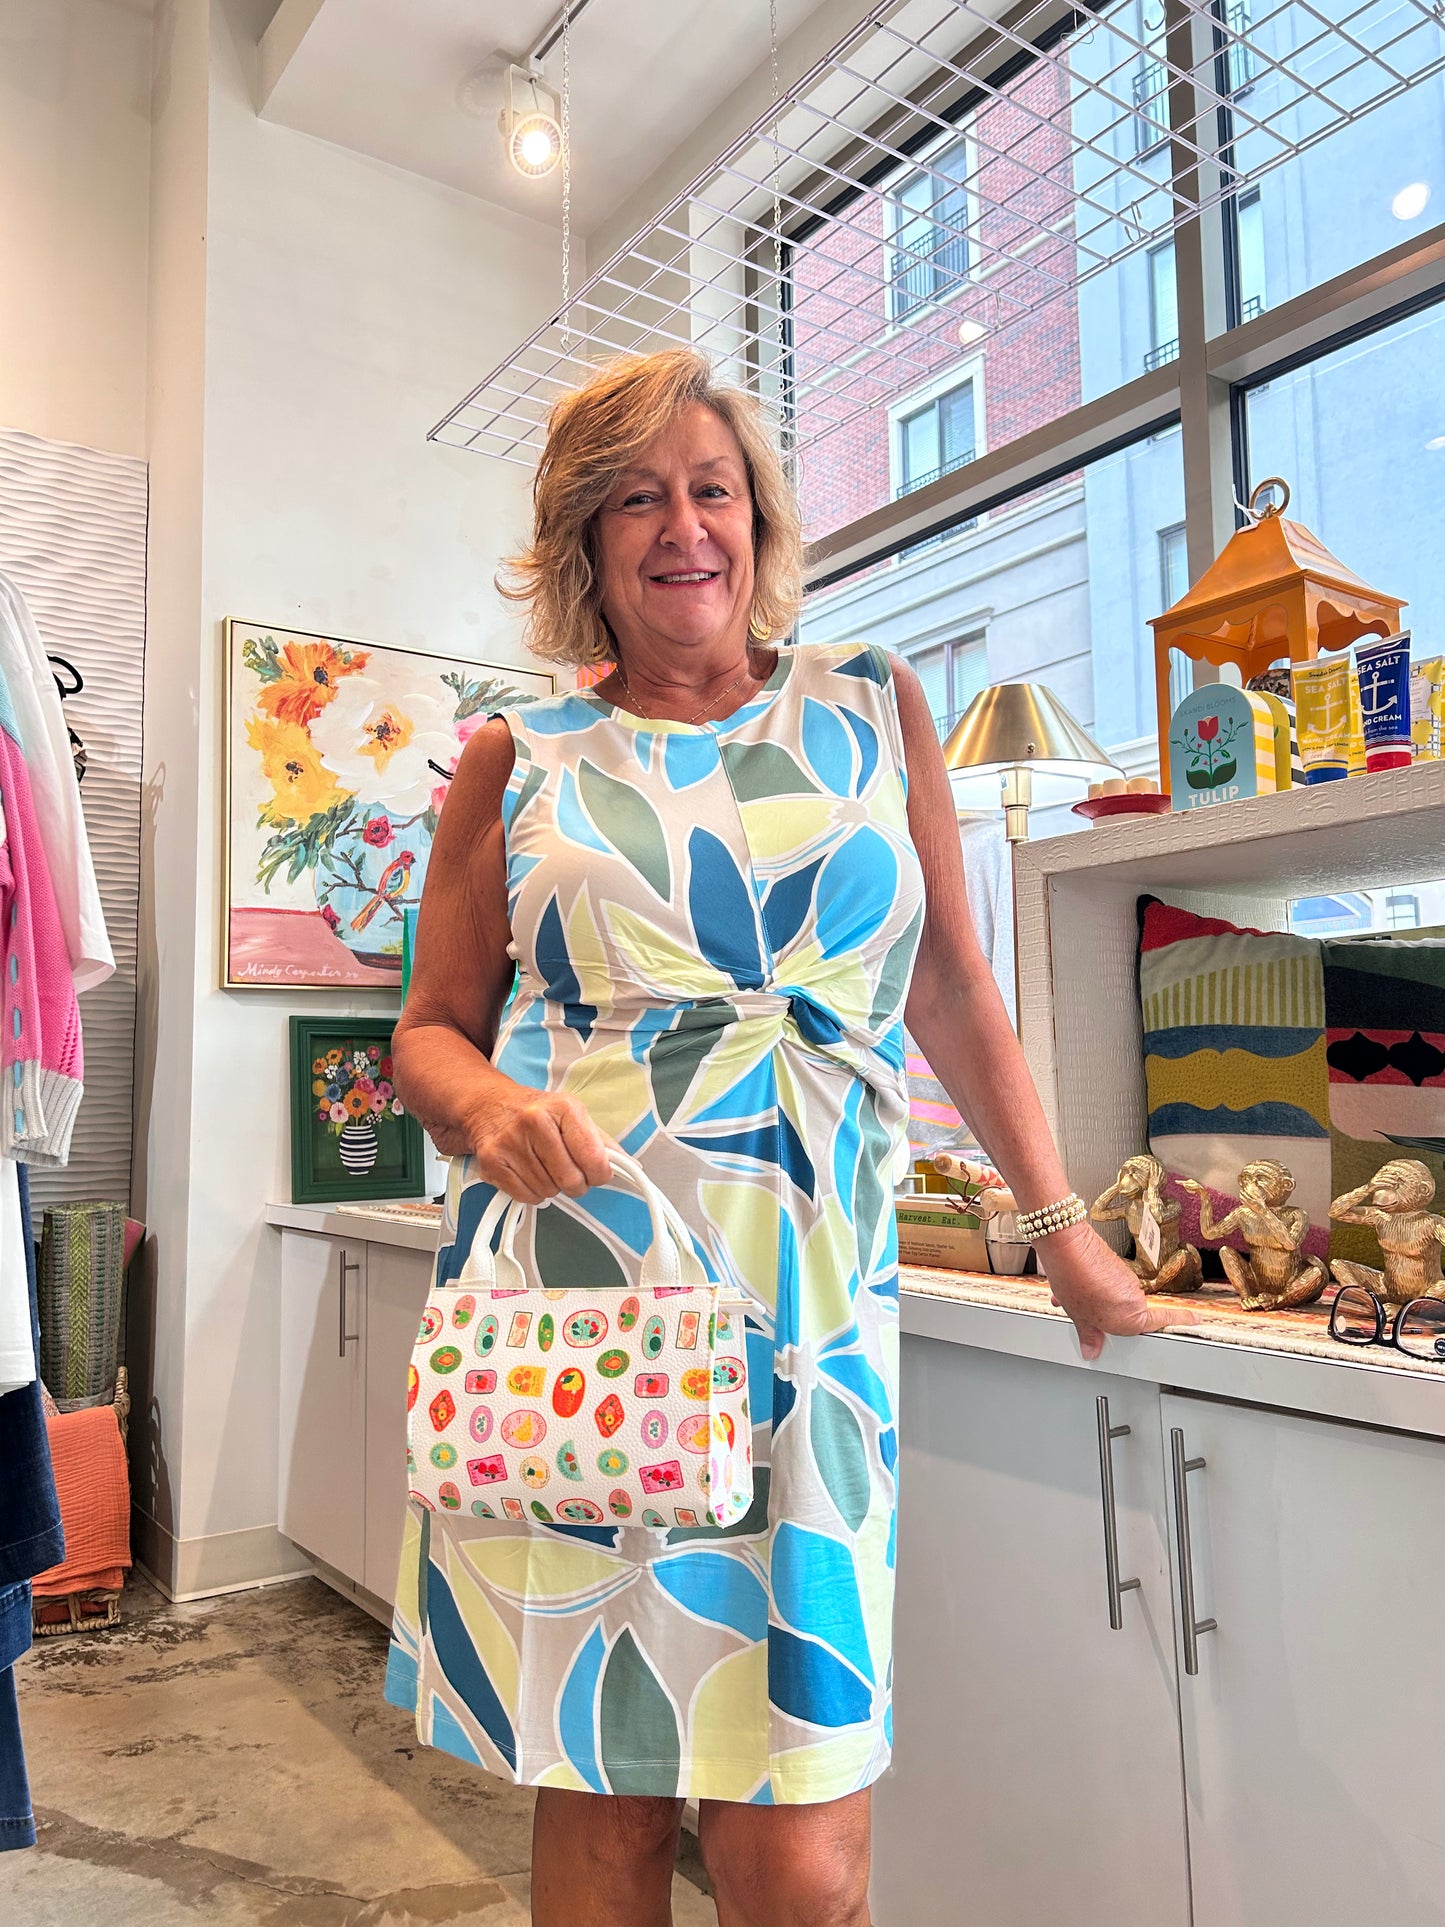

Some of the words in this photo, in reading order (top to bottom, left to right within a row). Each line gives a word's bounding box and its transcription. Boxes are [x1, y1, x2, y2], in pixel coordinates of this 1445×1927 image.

[1358, 664, 1373, 675] SEA
[1375, 656, 1400, 669] SALT
[1304, 686, 1325, 694] SEA
[1327, 678, 1347, 691] SALT
[1373, 714, 1402, 724] CREAM
[1188, 785, 1239, 807] TULIP
[237, 962, 282, 978] Mindy
[898, 1213, 935, 1223] Harvest.
[941, 1216, 960, 1225] Eat.
